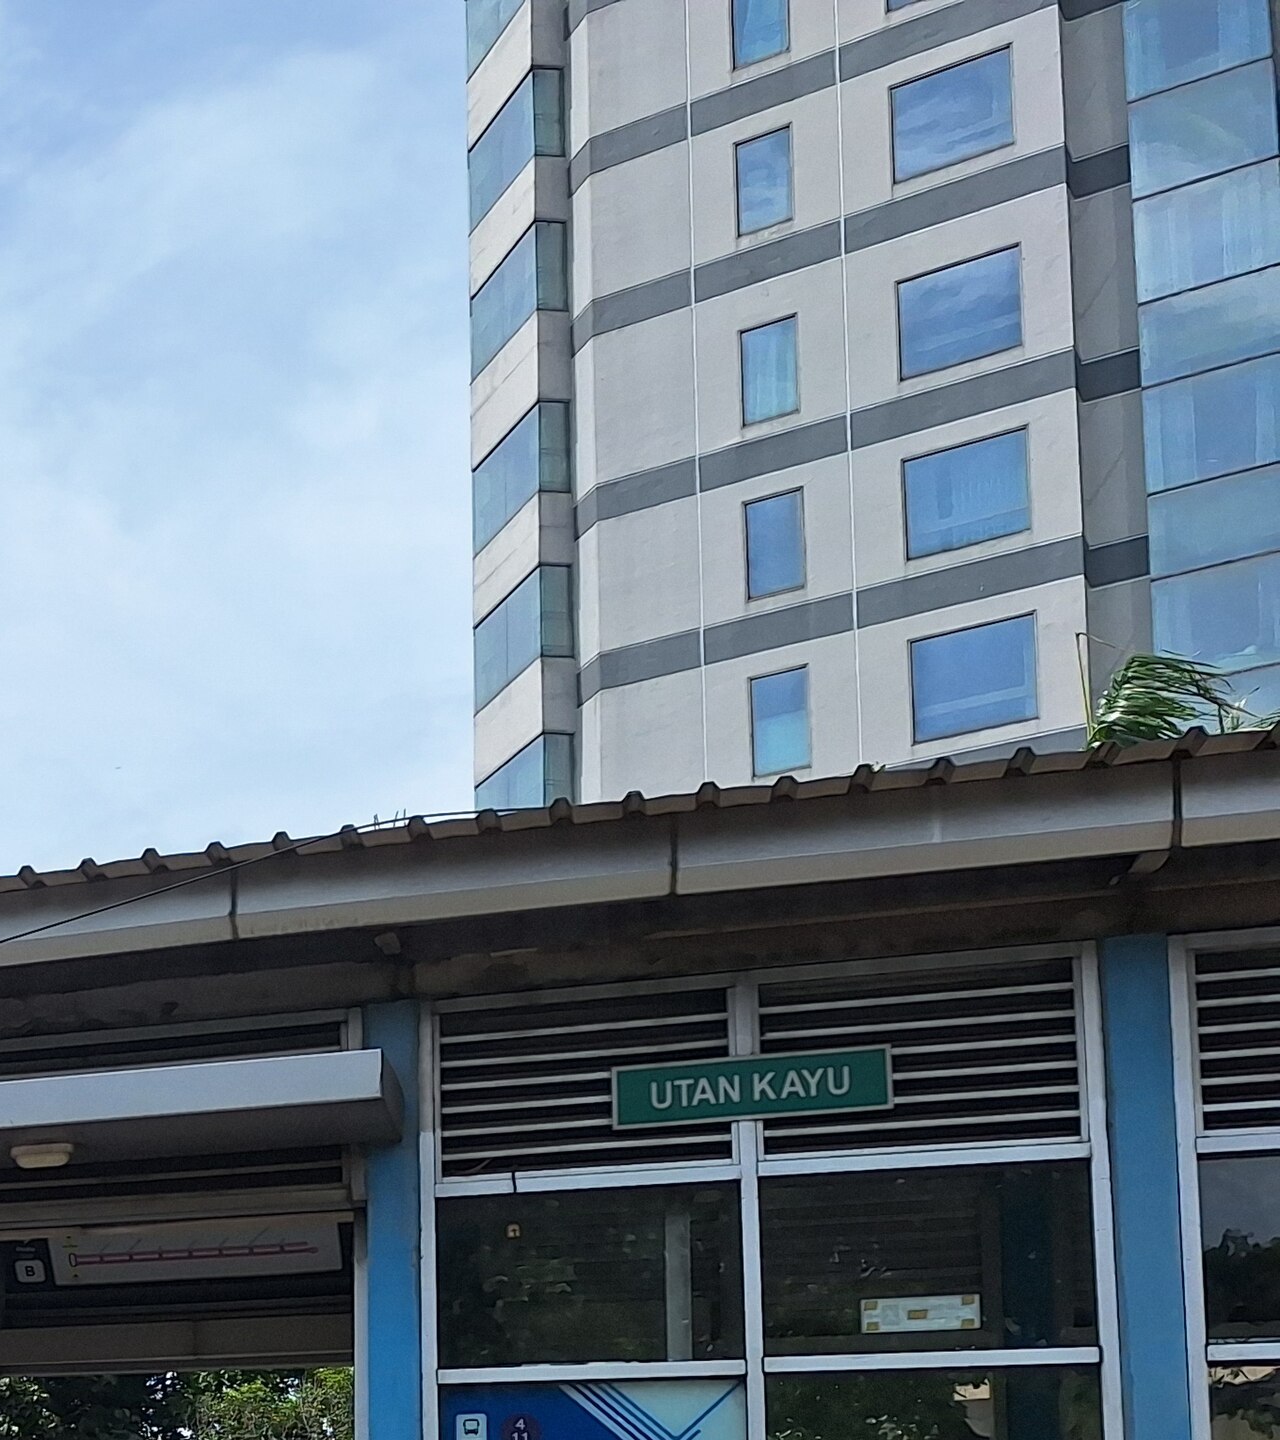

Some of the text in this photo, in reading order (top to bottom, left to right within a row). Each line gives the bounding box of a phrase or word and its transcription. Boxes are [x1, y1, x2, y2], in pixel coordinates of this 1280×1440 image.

[650, 1066, 850, 1110] UTAN KAYU
[515, 1418, 525, 1430] 4
